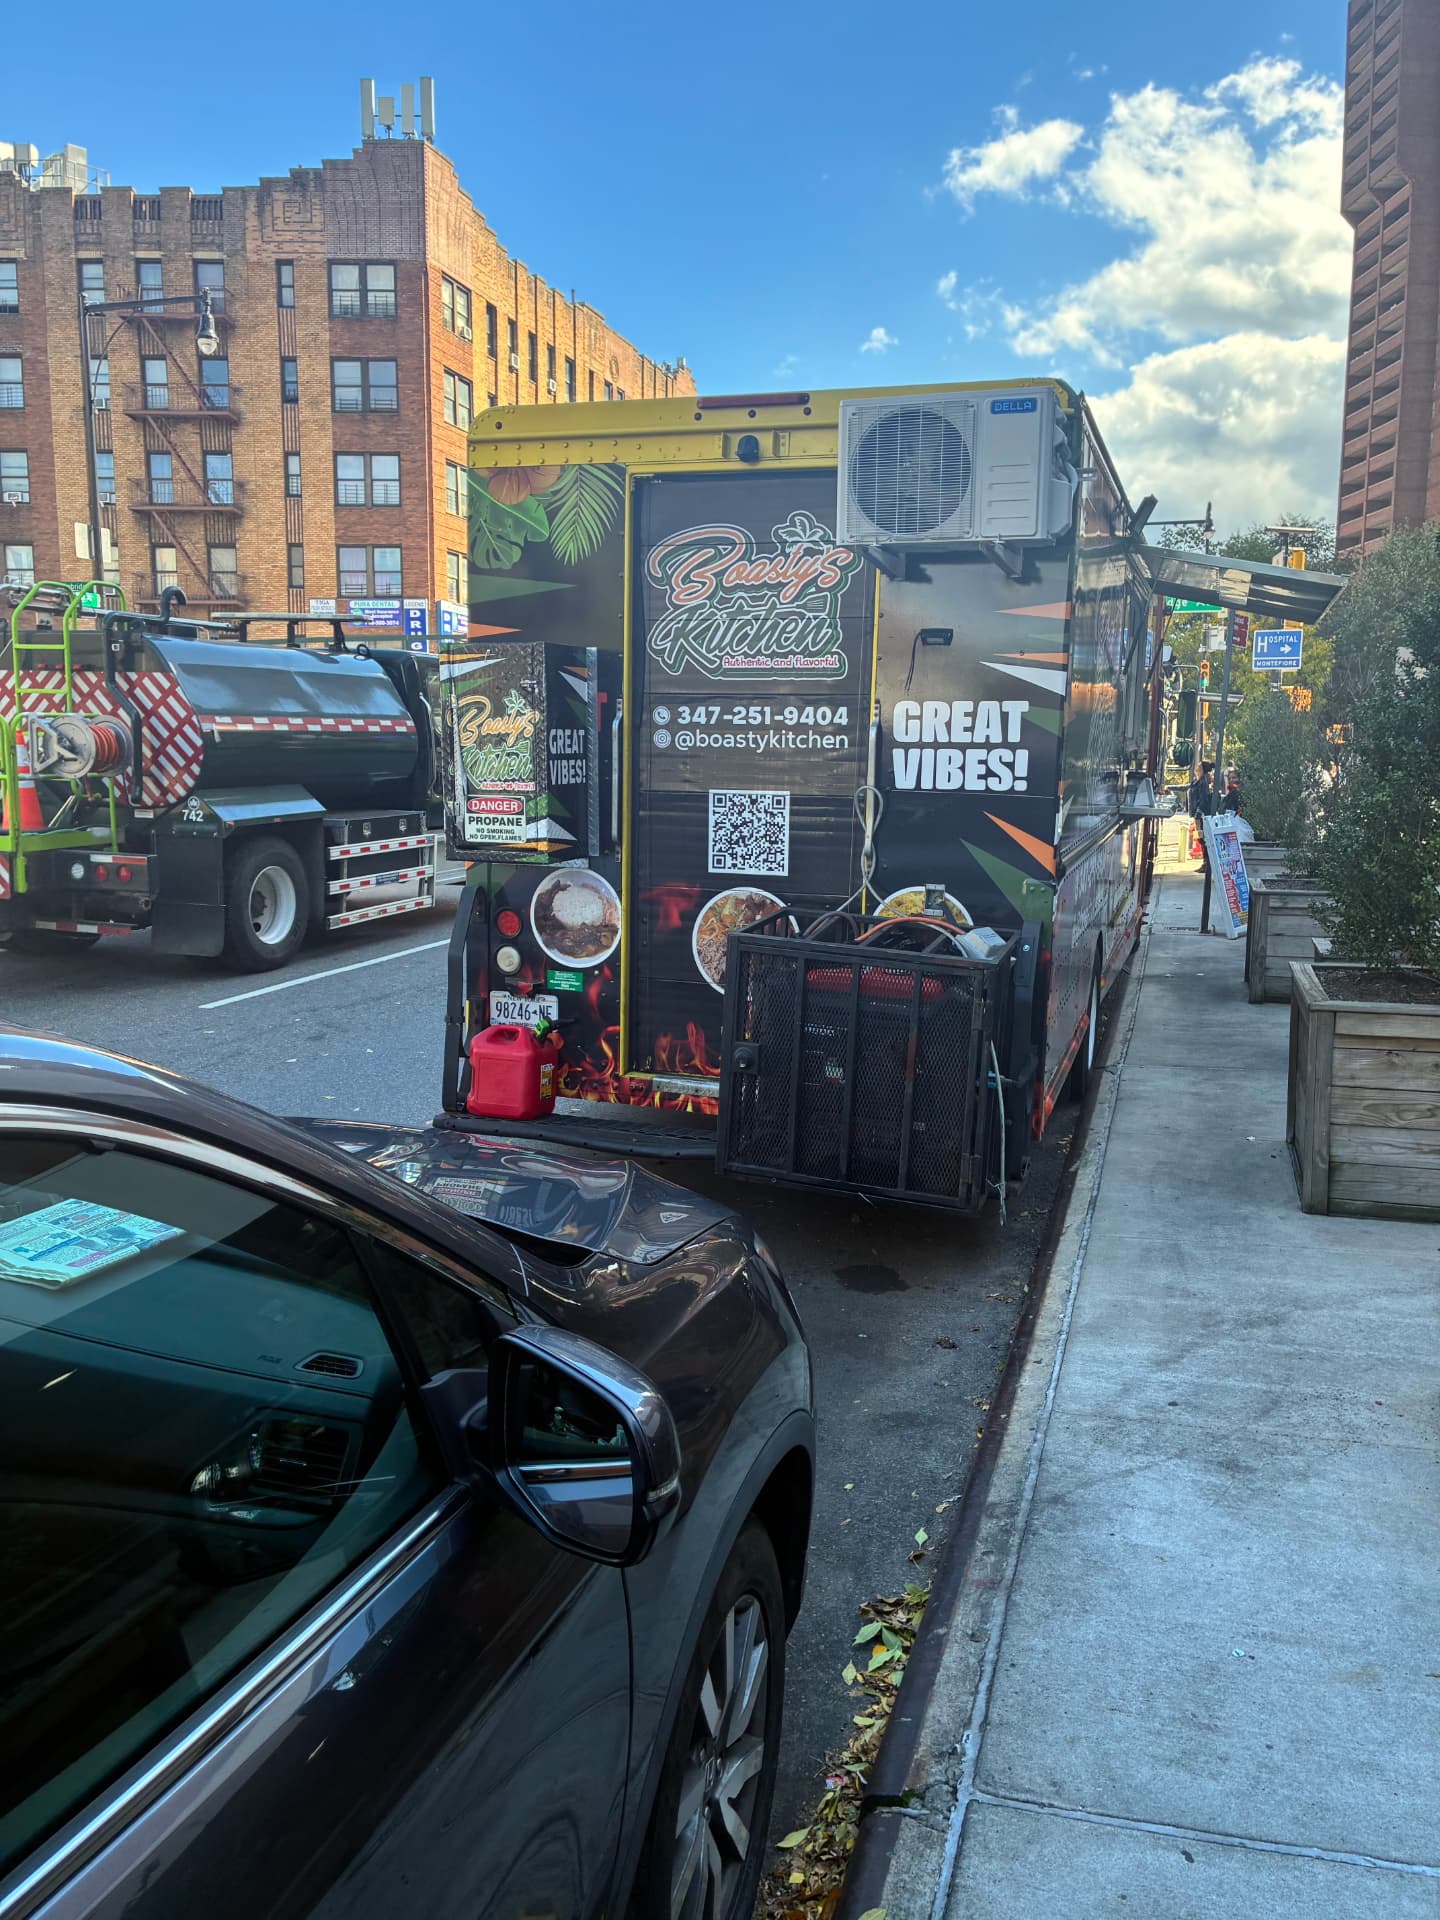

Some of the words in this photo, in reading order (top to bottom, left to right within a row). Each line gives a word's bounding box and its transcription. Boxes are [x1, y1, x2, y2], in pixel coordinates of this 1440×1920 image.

[994, 401, 1032, 411] DELLA
[651, 597, 835, 668] Kitchen
[1257, 635, 1298, 653] HOSPITAL
[722, 656, 771, 668] Authentic
[773, 656, 793, 668] and
[793, 655, 840, 668] flavorful
[1256, 659, 1298, 668] MONTEFIORE
[677, 706, 849, 726] 347-251-9404
[892, 700, 1030, 743] GREAT
[549, 728, 586, 755] GREAT
[674, 729, 849, 754] @boastykitchen
[549, 759, 586, 786] VIBES!
[892, 748, 1030, 792] VIBES!
[181, 809, 204, 823] 742
[471, 800, 519, 812] DANGER
[468, 816, 523, 827] PROPANE
[495, 1001, 531, 1021] 98246
